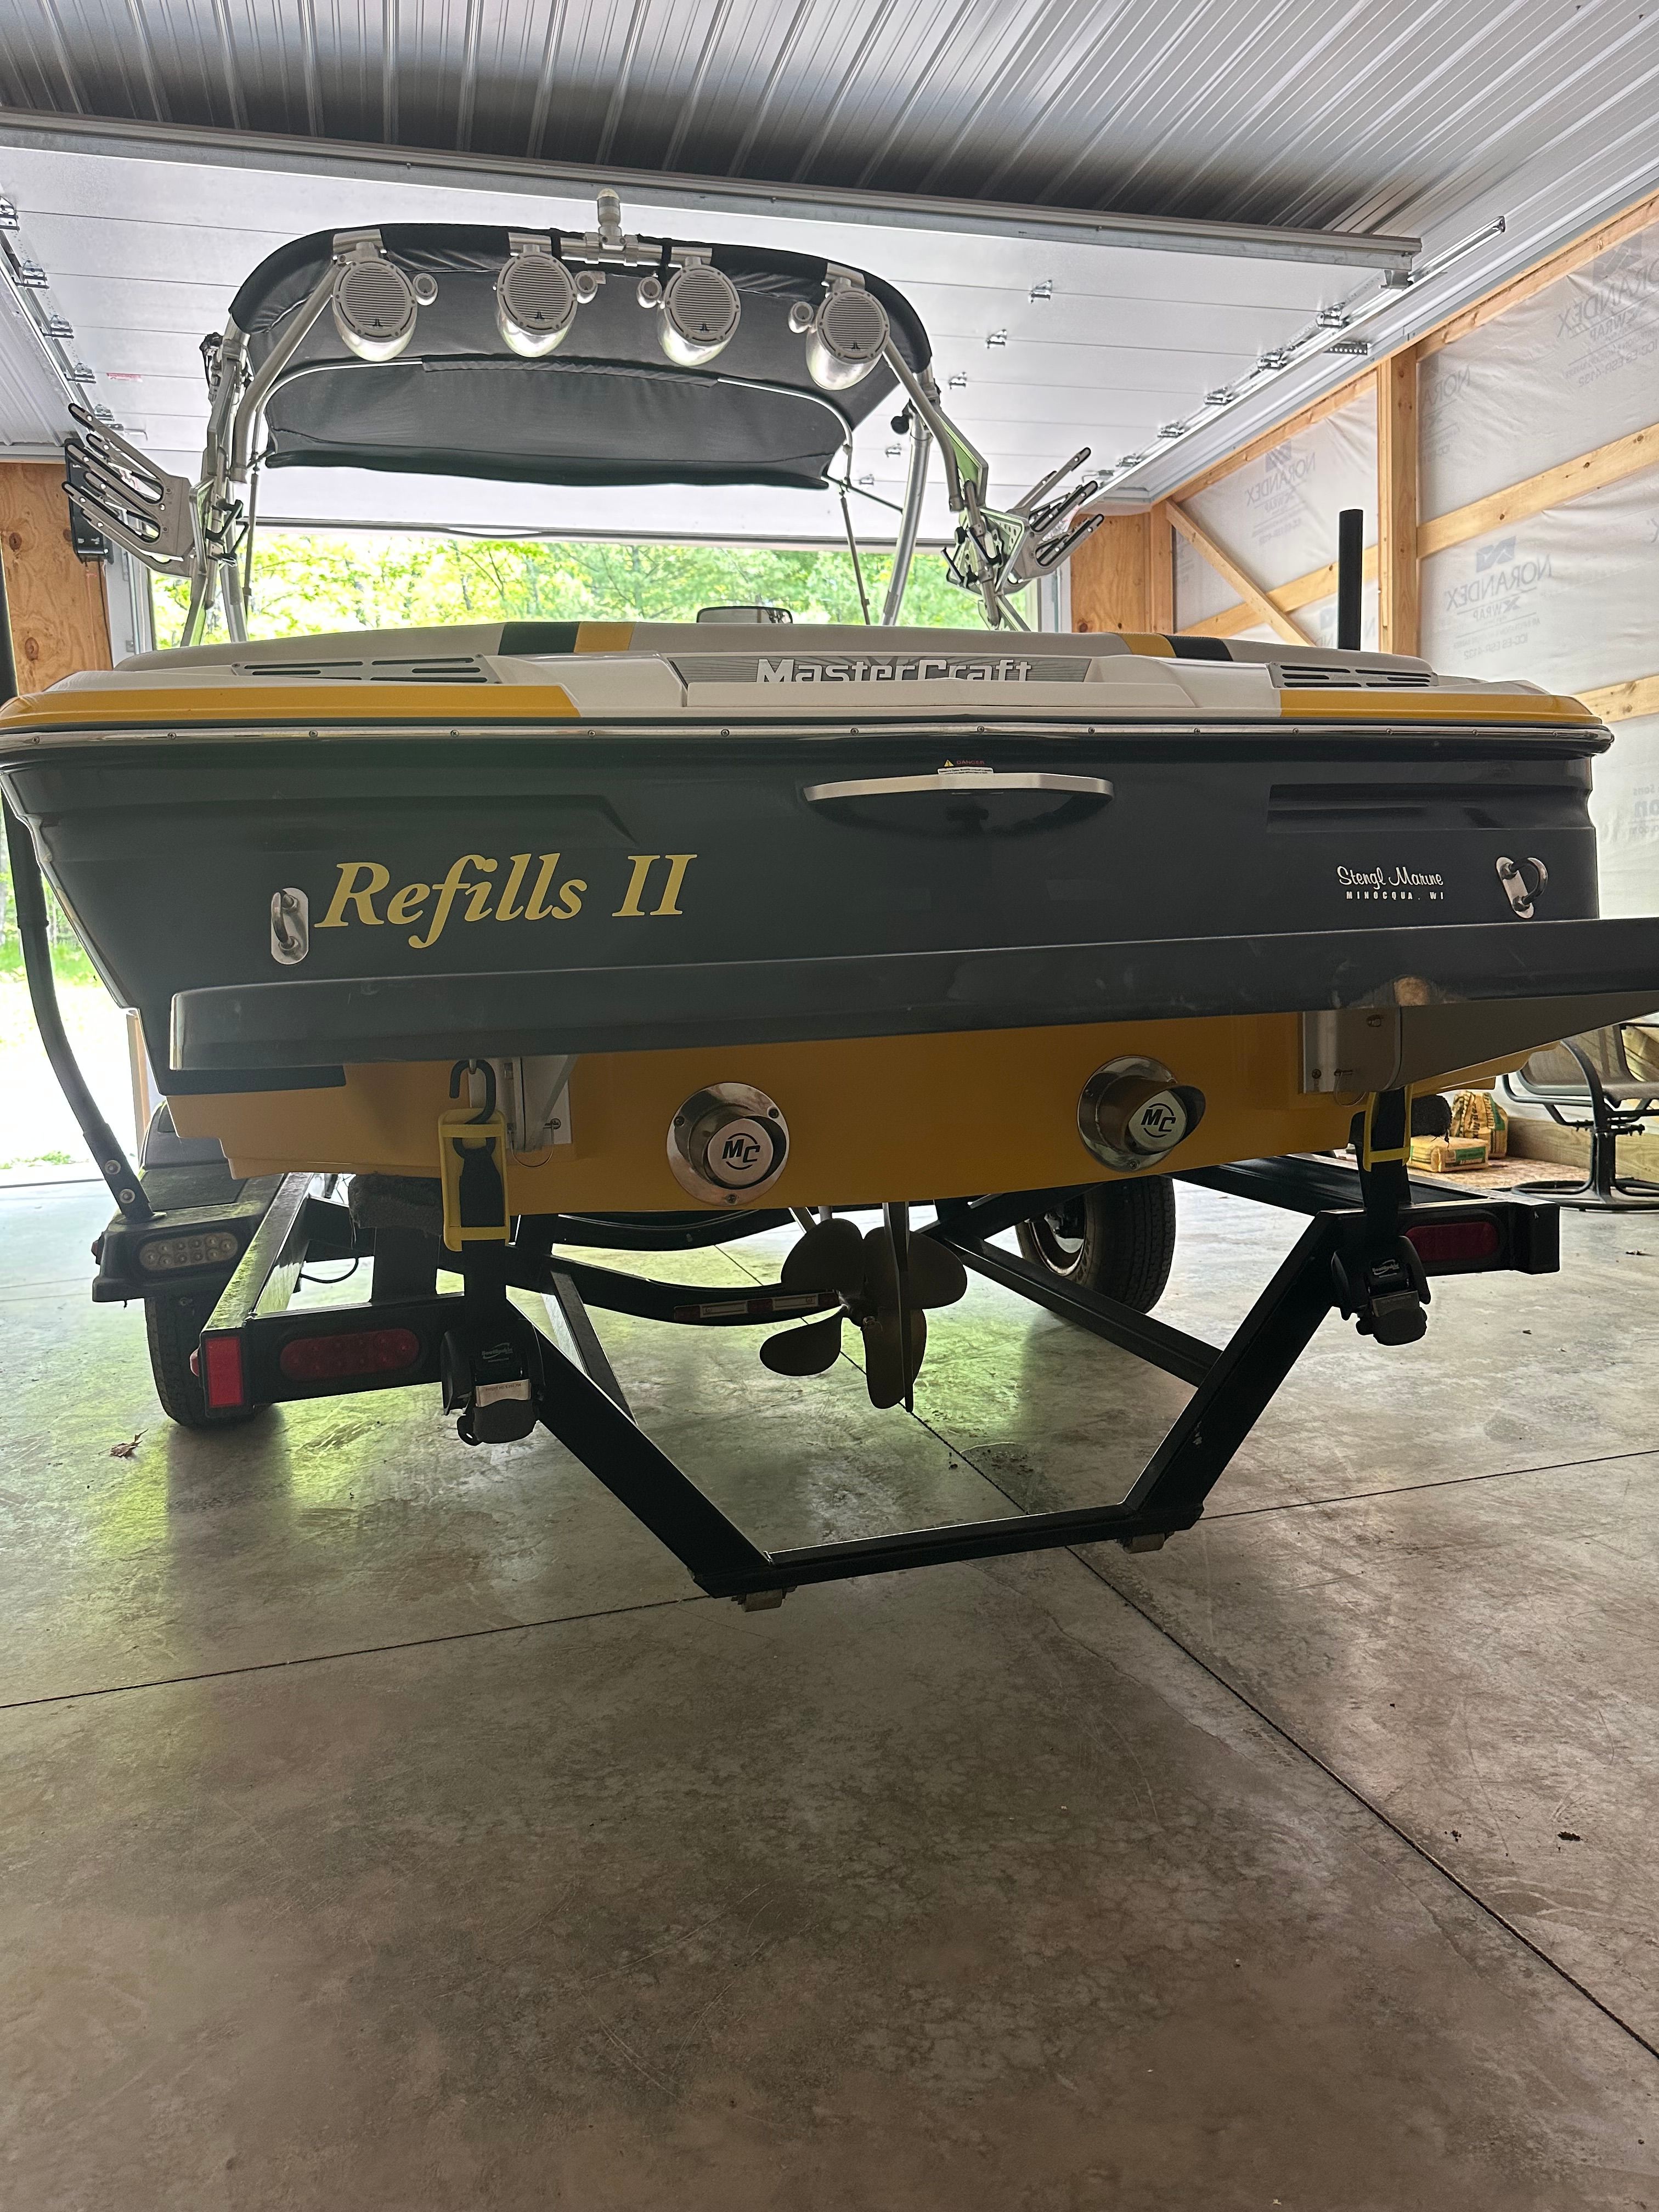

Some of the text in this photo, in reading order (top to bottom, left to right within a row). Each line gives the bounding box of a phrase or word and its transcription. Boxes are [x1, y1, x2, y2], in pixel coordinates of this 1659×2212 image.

[756, 658, 1032, 682] MasterCraft
[1337, 865, 1443, 890] Stengl Marine
[314, 853, 697, 949] Refills II
[1429, 891, 1443, 900] WI
[1141, 1109, 1176, 1132] MC
[722, 1138, 761, 1163] MC
